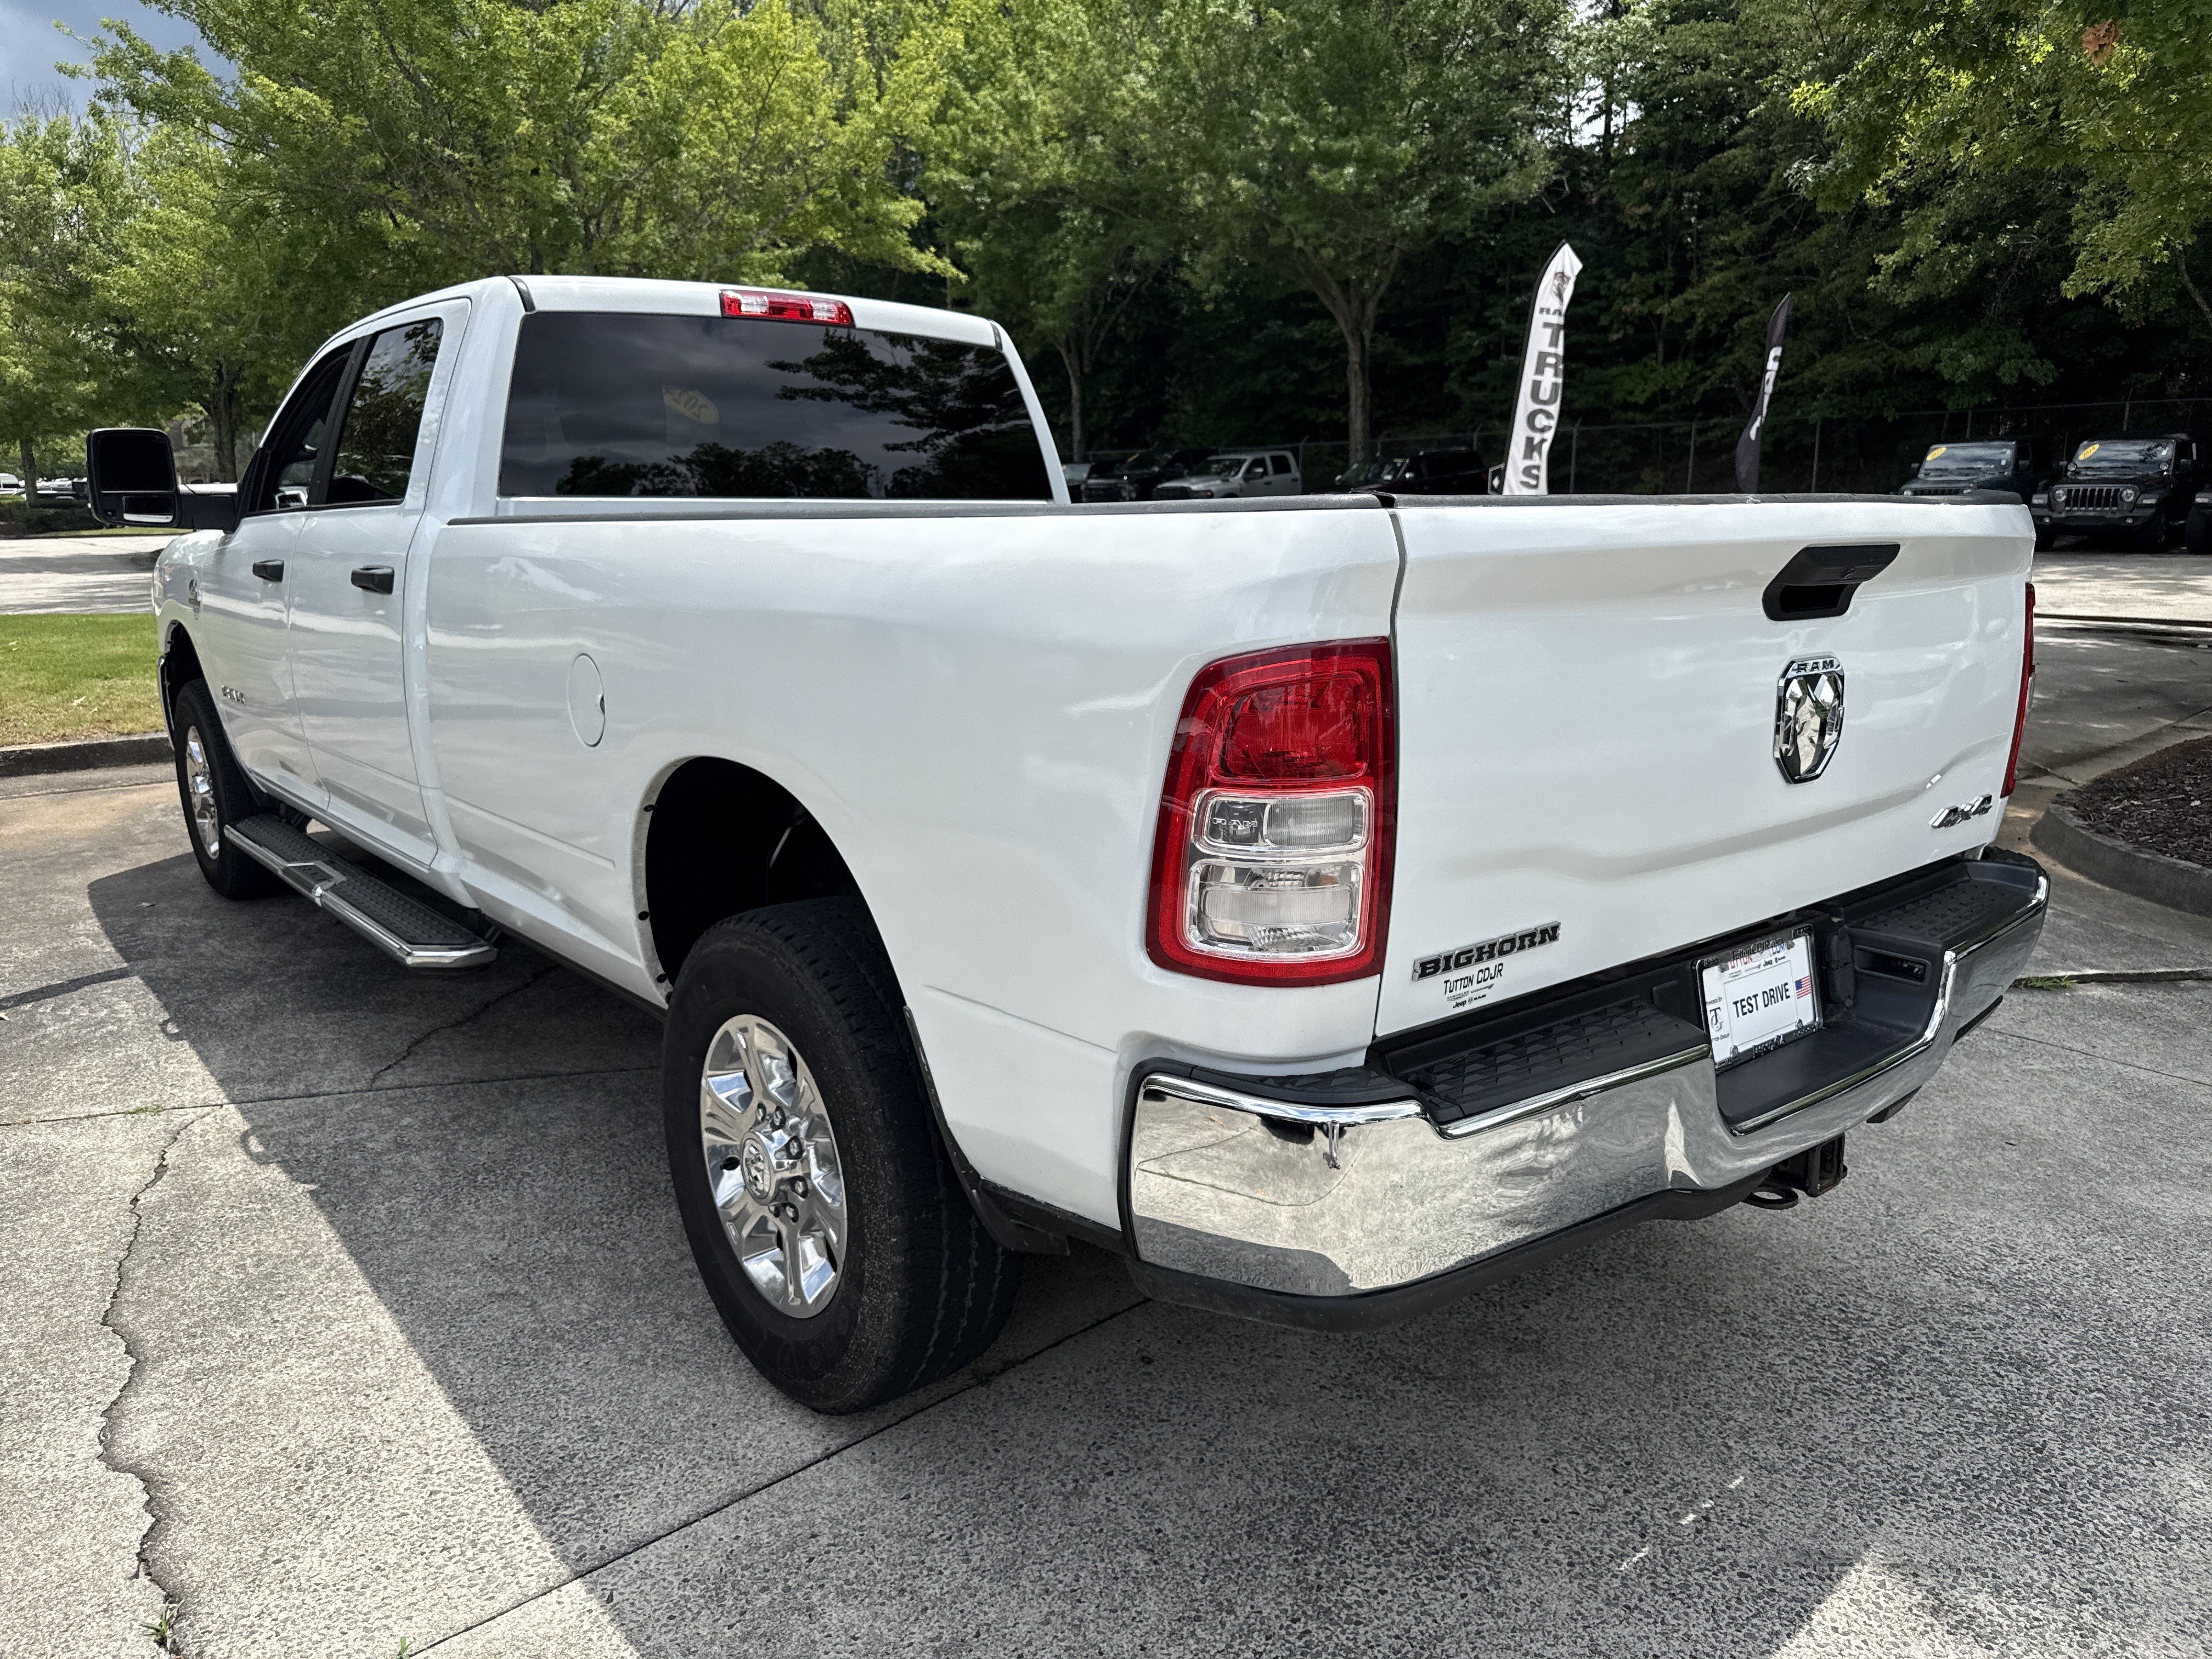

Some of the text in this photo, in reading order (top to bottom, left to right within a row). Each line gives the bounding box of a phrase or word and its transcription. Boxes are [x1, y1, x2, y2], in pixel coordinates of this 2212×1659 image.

[1520, 321, 1564, 490] TRUCKS
[1793, 659, 1835, 674] RAM
[1212, 817, 1258, 828] RAM
[1412, 922, 1561, 980] BIGHORN
[1476, 962, 1504, 984] CDJR
[1453, 1000, 1467, 1009] Jeep
[1733, 982, 1791, 1018] TEST DRIVE
